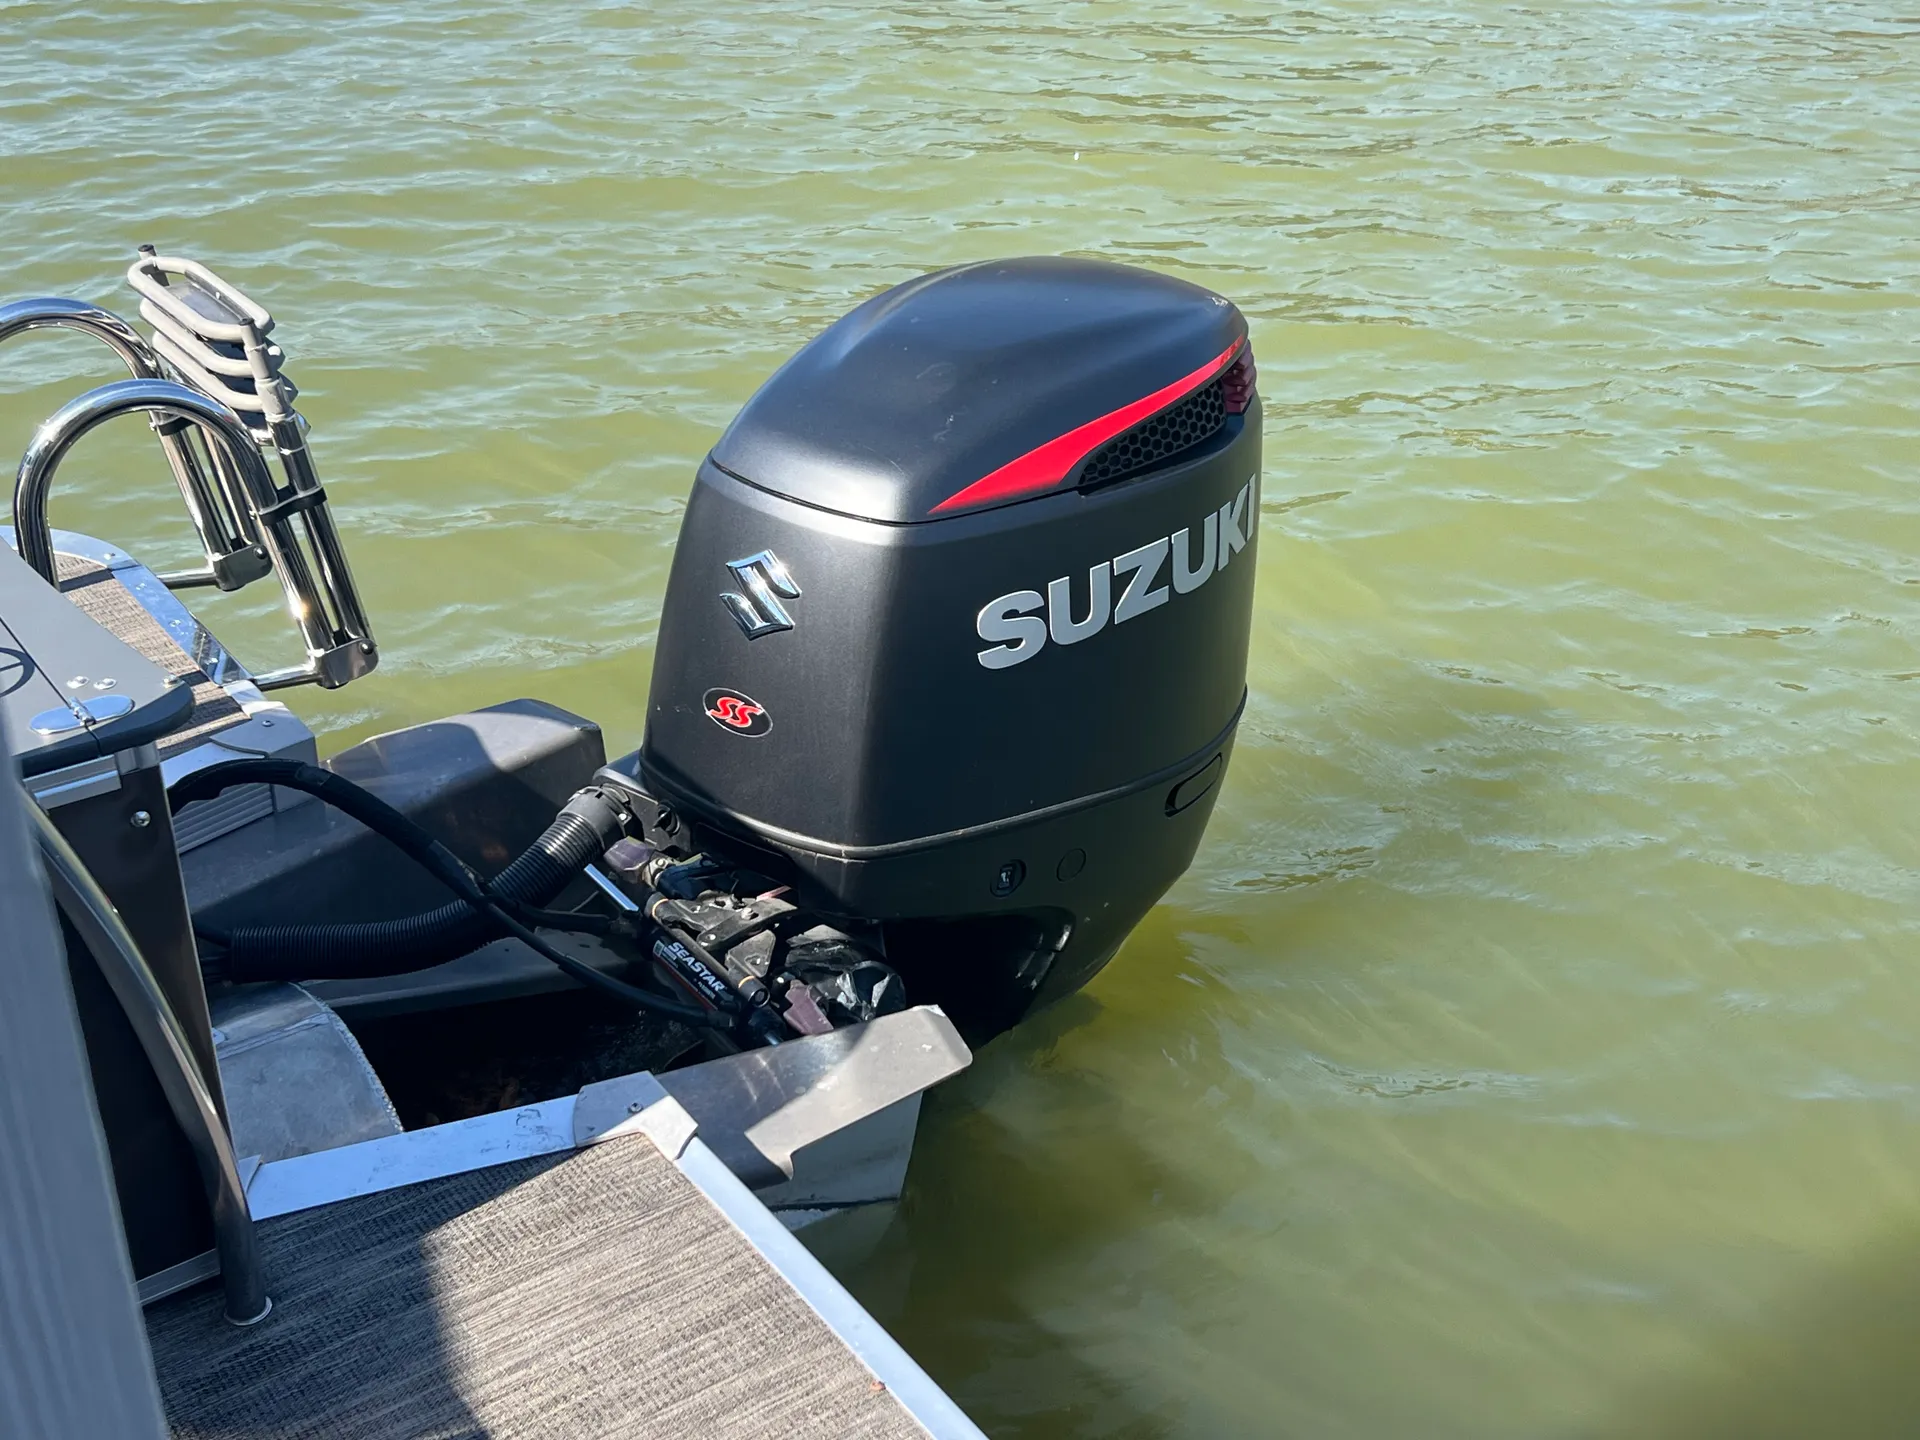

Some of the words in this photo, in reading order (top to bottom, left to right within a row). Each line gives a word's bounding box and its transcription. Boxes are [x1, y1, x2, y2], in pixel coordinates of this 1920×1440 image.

[977, 474, 1256, 670] SUZUKI
[709, 696, 764, 727] SS
[668, 941, 726, 991] SEASTAR
